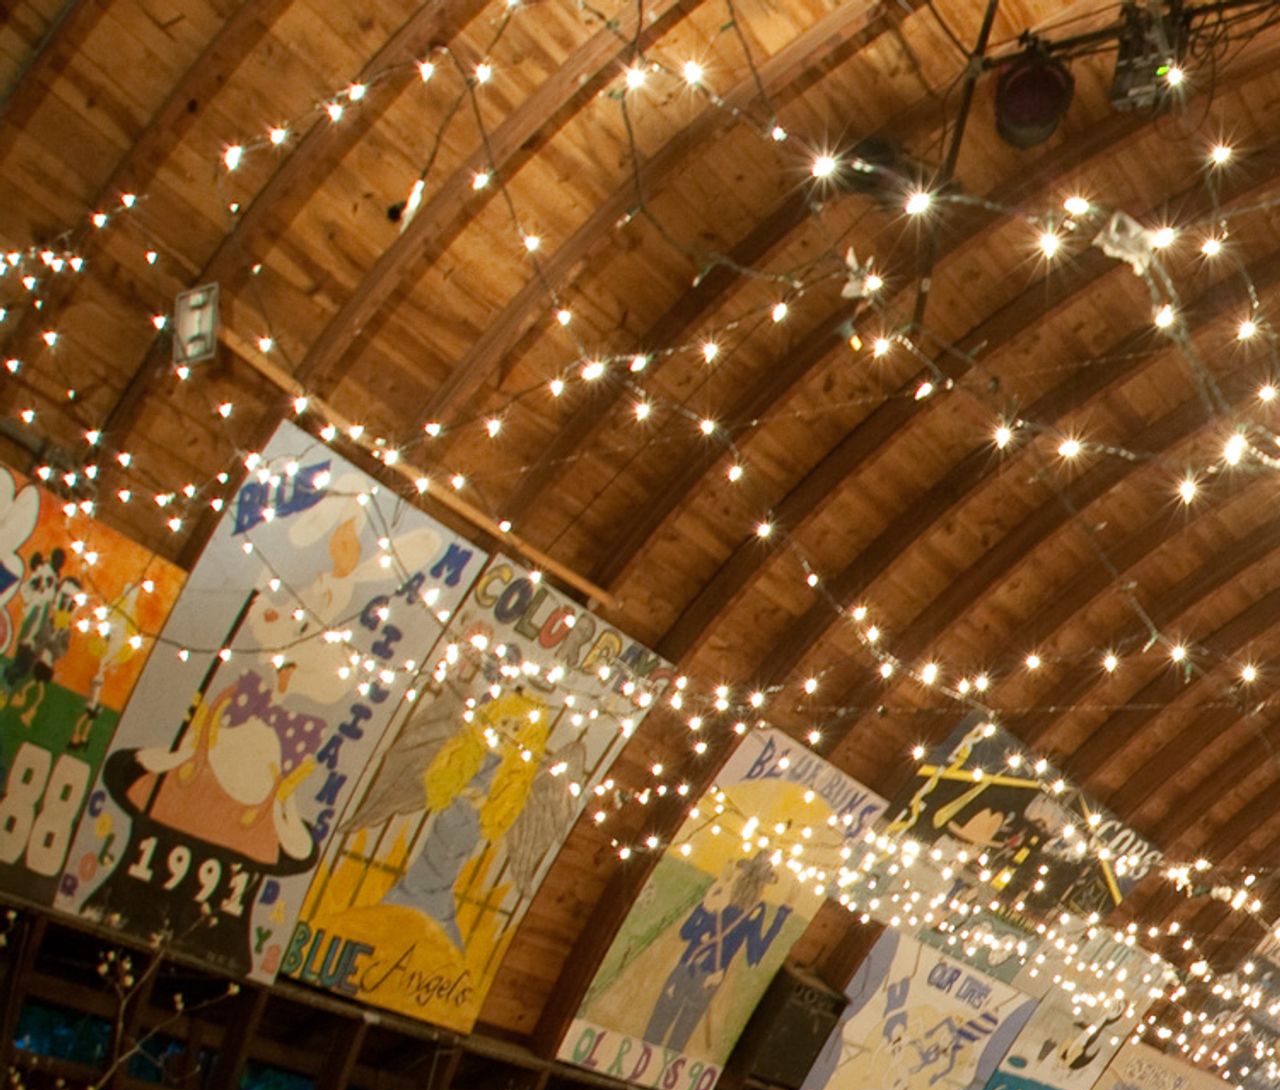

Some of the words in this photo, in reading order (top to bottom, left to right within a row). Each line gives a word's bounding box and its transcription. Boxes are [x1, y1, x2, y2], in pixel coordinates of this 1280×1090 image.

[475, 564, 596, 666] COLOR
[128, 836, 250, 917] 1991
[281, 920, 375, 995] BLUE
[361, 944, 473, 1007] Angels
